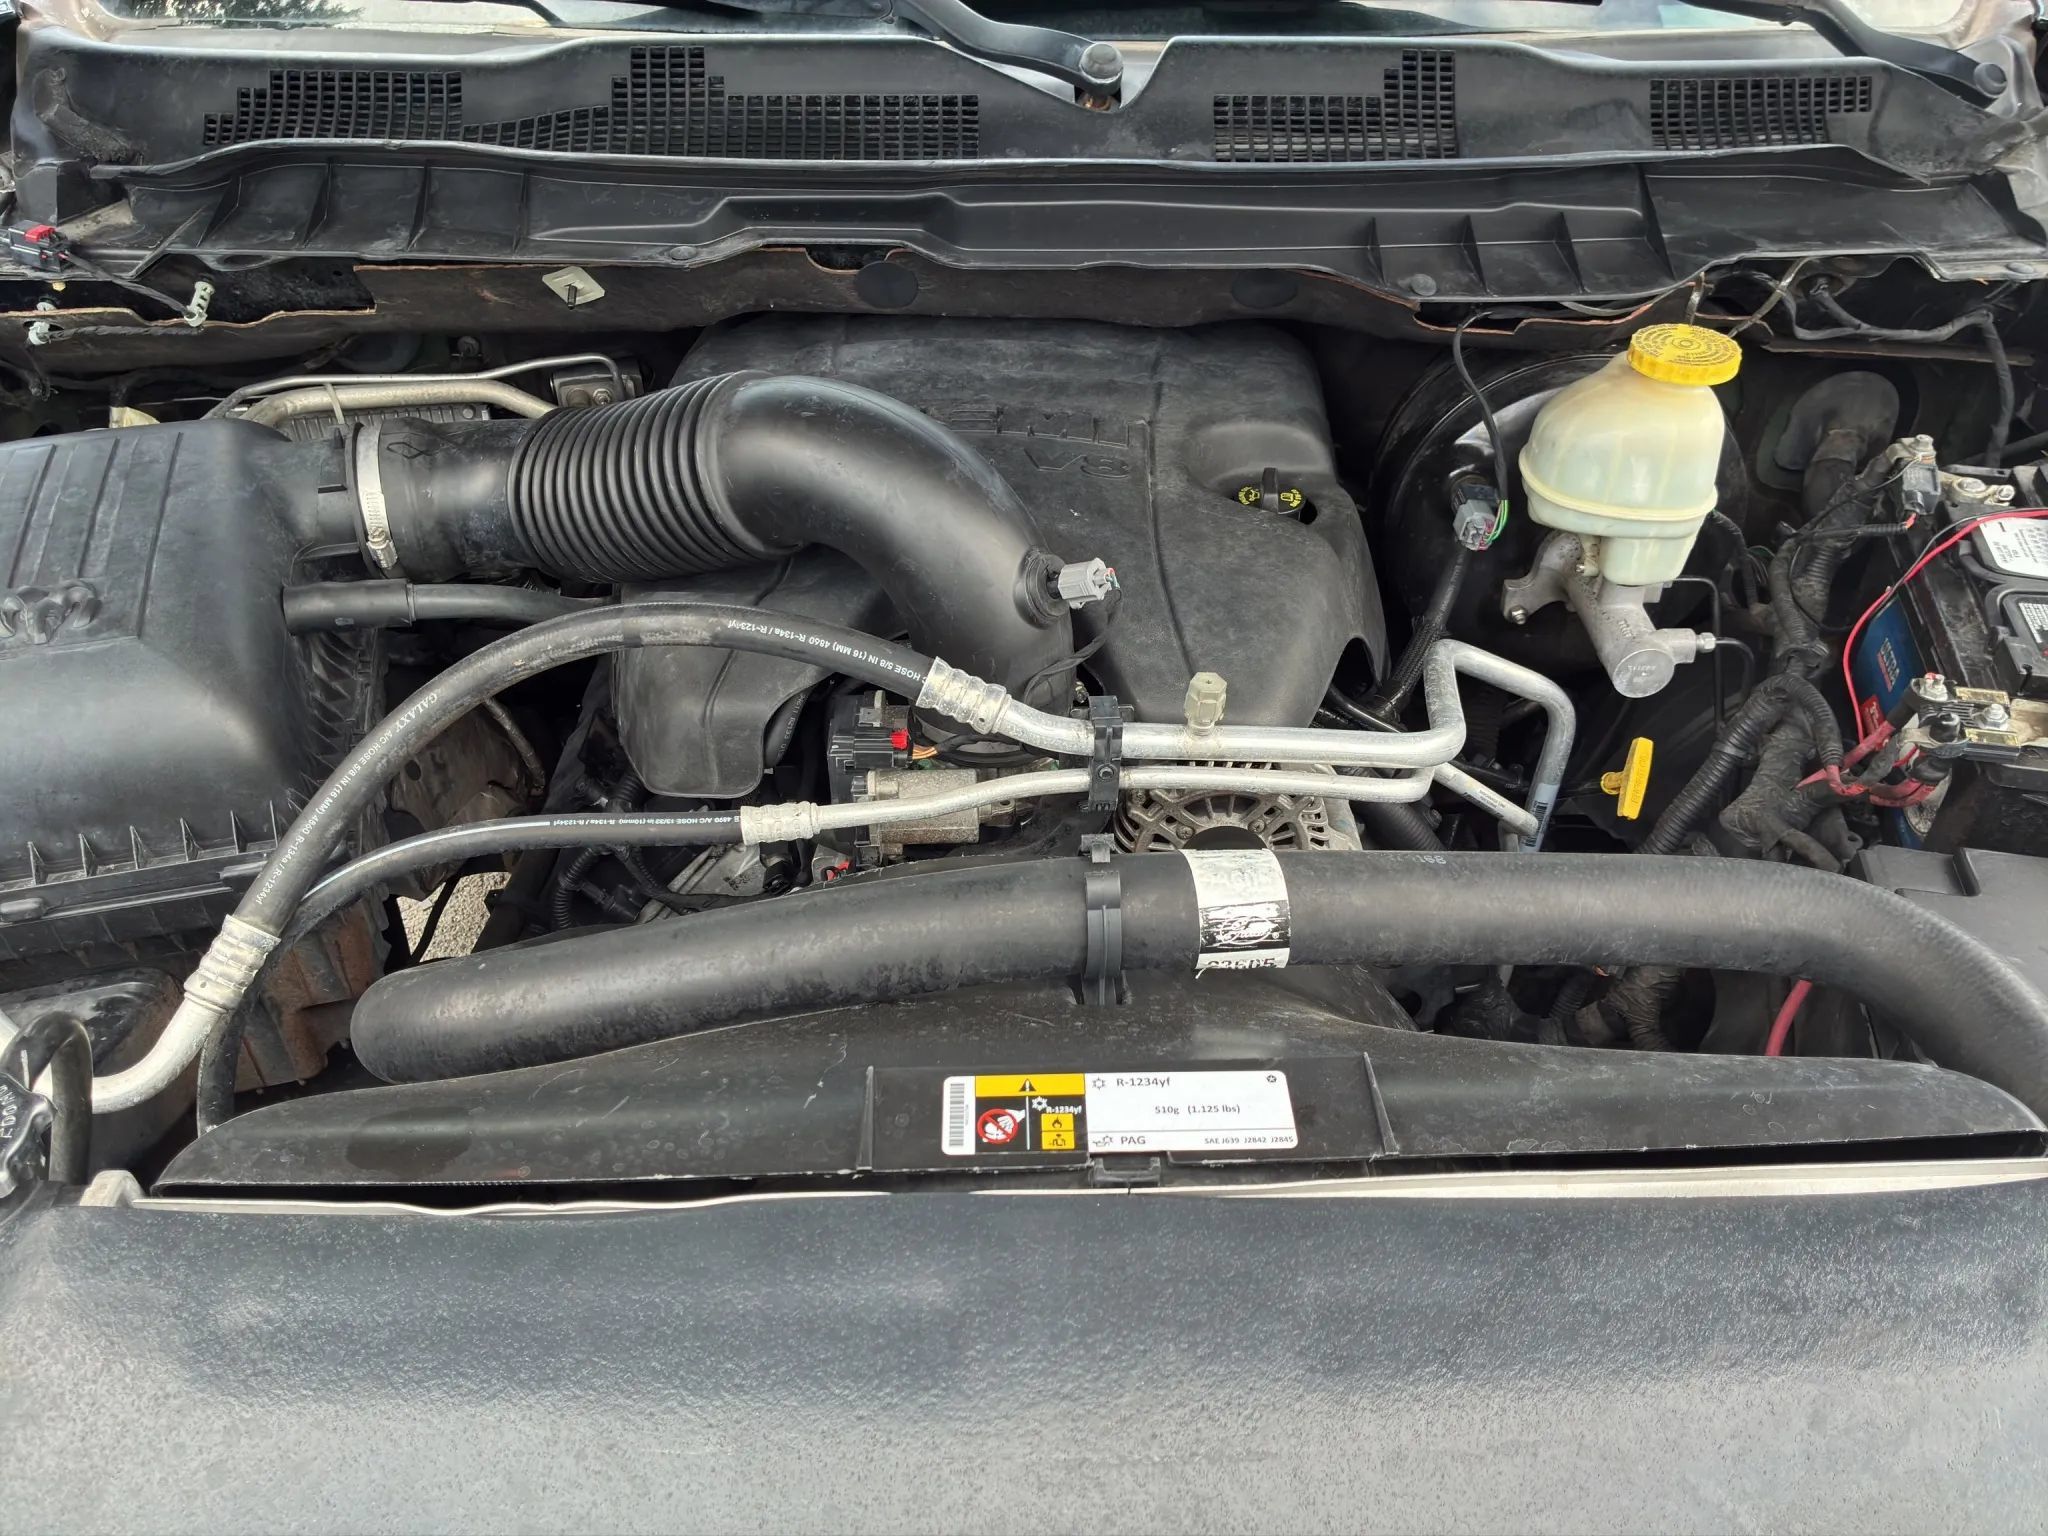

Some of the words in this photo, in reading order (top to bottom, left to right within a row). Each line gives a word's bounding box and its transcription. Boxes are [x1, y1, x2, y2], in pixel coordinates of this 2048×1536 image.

[1023, 448, 1130, 480] V8
[774, 628, 807, 643] R-134a
[809, 636, 831, 649] 4860
[832, 641, 852, 655] MM)
[853, 649, 867, 660] (16
[868, 654, 879, 665] IN
[880, 659, 893, 670] 5/8
[894, 664, 921, 681] HOSE
[395, 692, 438, 733] GALAXY
[379, 730, 393, 744] A/C
[358, 742, 381, 766] HOSE
[348, 763, 361, 777] 5/8
[340, 774, 352, 786] IN
[330, 784, 343, 798] (16
[315, 797, 333, 815] MM)
[302, 814, 319, 835] 4860
[676, 817, 698, 825] HOSE
[281, 834, 305, 864] R-134a
[255, 868, 283, 905] R-1234yf
[1116, 1077, 1171, 1088] R-1234yf
[1046, 1104, 1082, 1115] R-1234yf
[1155, 1105, 1180, 1115] 510g
[1222, 1104, 1241, 1115] lbs)
[1120, 1136, 1146, 1145] PAG
[1222, 1136, 1240, 1144] J639
